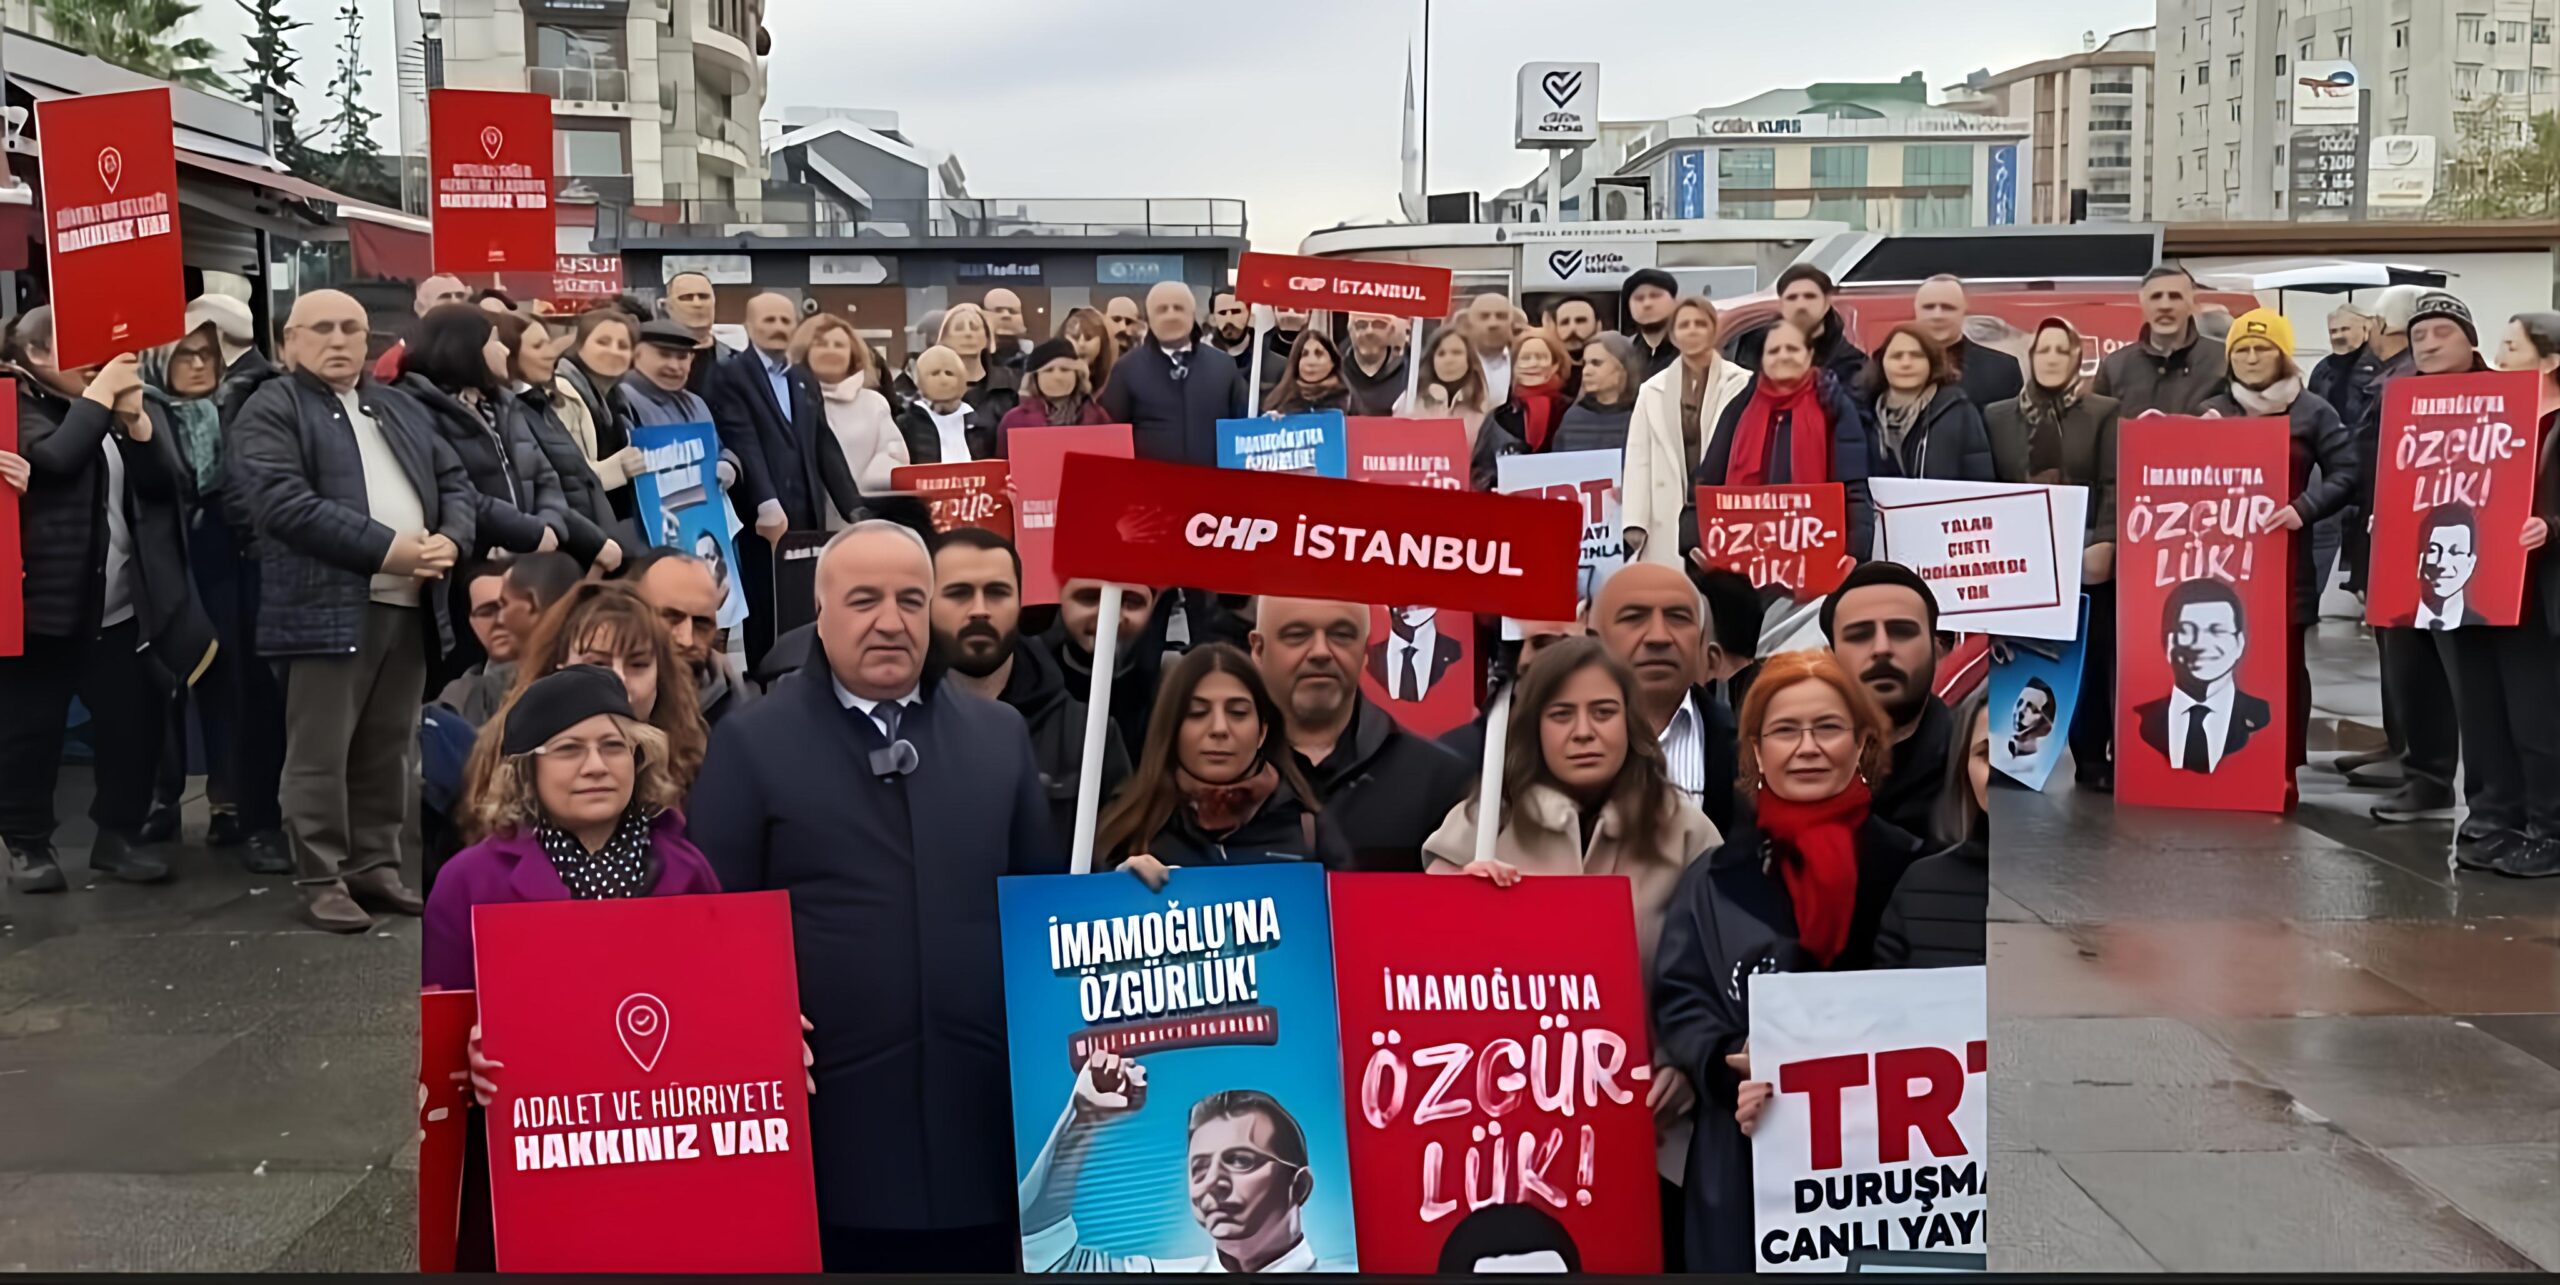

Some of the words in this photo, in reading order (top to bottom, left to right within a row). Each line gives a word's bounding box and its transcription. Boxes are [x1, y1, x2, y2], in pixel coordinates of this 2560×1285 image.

[1333, 278, 1426, 300] İSTANBUL
[2396, 414, 2527, 470] ÖZGÜR-
[2413, 466, 2493, 512] LÜK!
[1185, 512, 1278, 551] CHP
[1294, 514, 1524, 577] İSTANBUL
[1708, 510, 1837, 557] ÖZGÜR-
[2155, 539, 2253, 588] LÜK!
[1049, 896, 1281, 970] İMAMOĞLU'NA
[1080, 950, 1258, 1022] ÖZGÜRLÜK!
[1384, 966, 1601, 1011] İMAMOĞLU'NA
[1361, 1013, 1651, 1129] ÖZGÜR-
[513, 1093, 604, 1129] ADALET
[613, 1089, 643, 1122] VE
[1779, 1041, 1987, 1170] TR
[514, 1123, 700, 1171] HAKKINIZ
[711, 1118, 790, 1156] VAR
[1419, 1120, 1595, 1222] LÜK!
[1794, 1161, 1987, 1214] DURUŞM
[1761, 1219, 1889, 1264] CANLI
